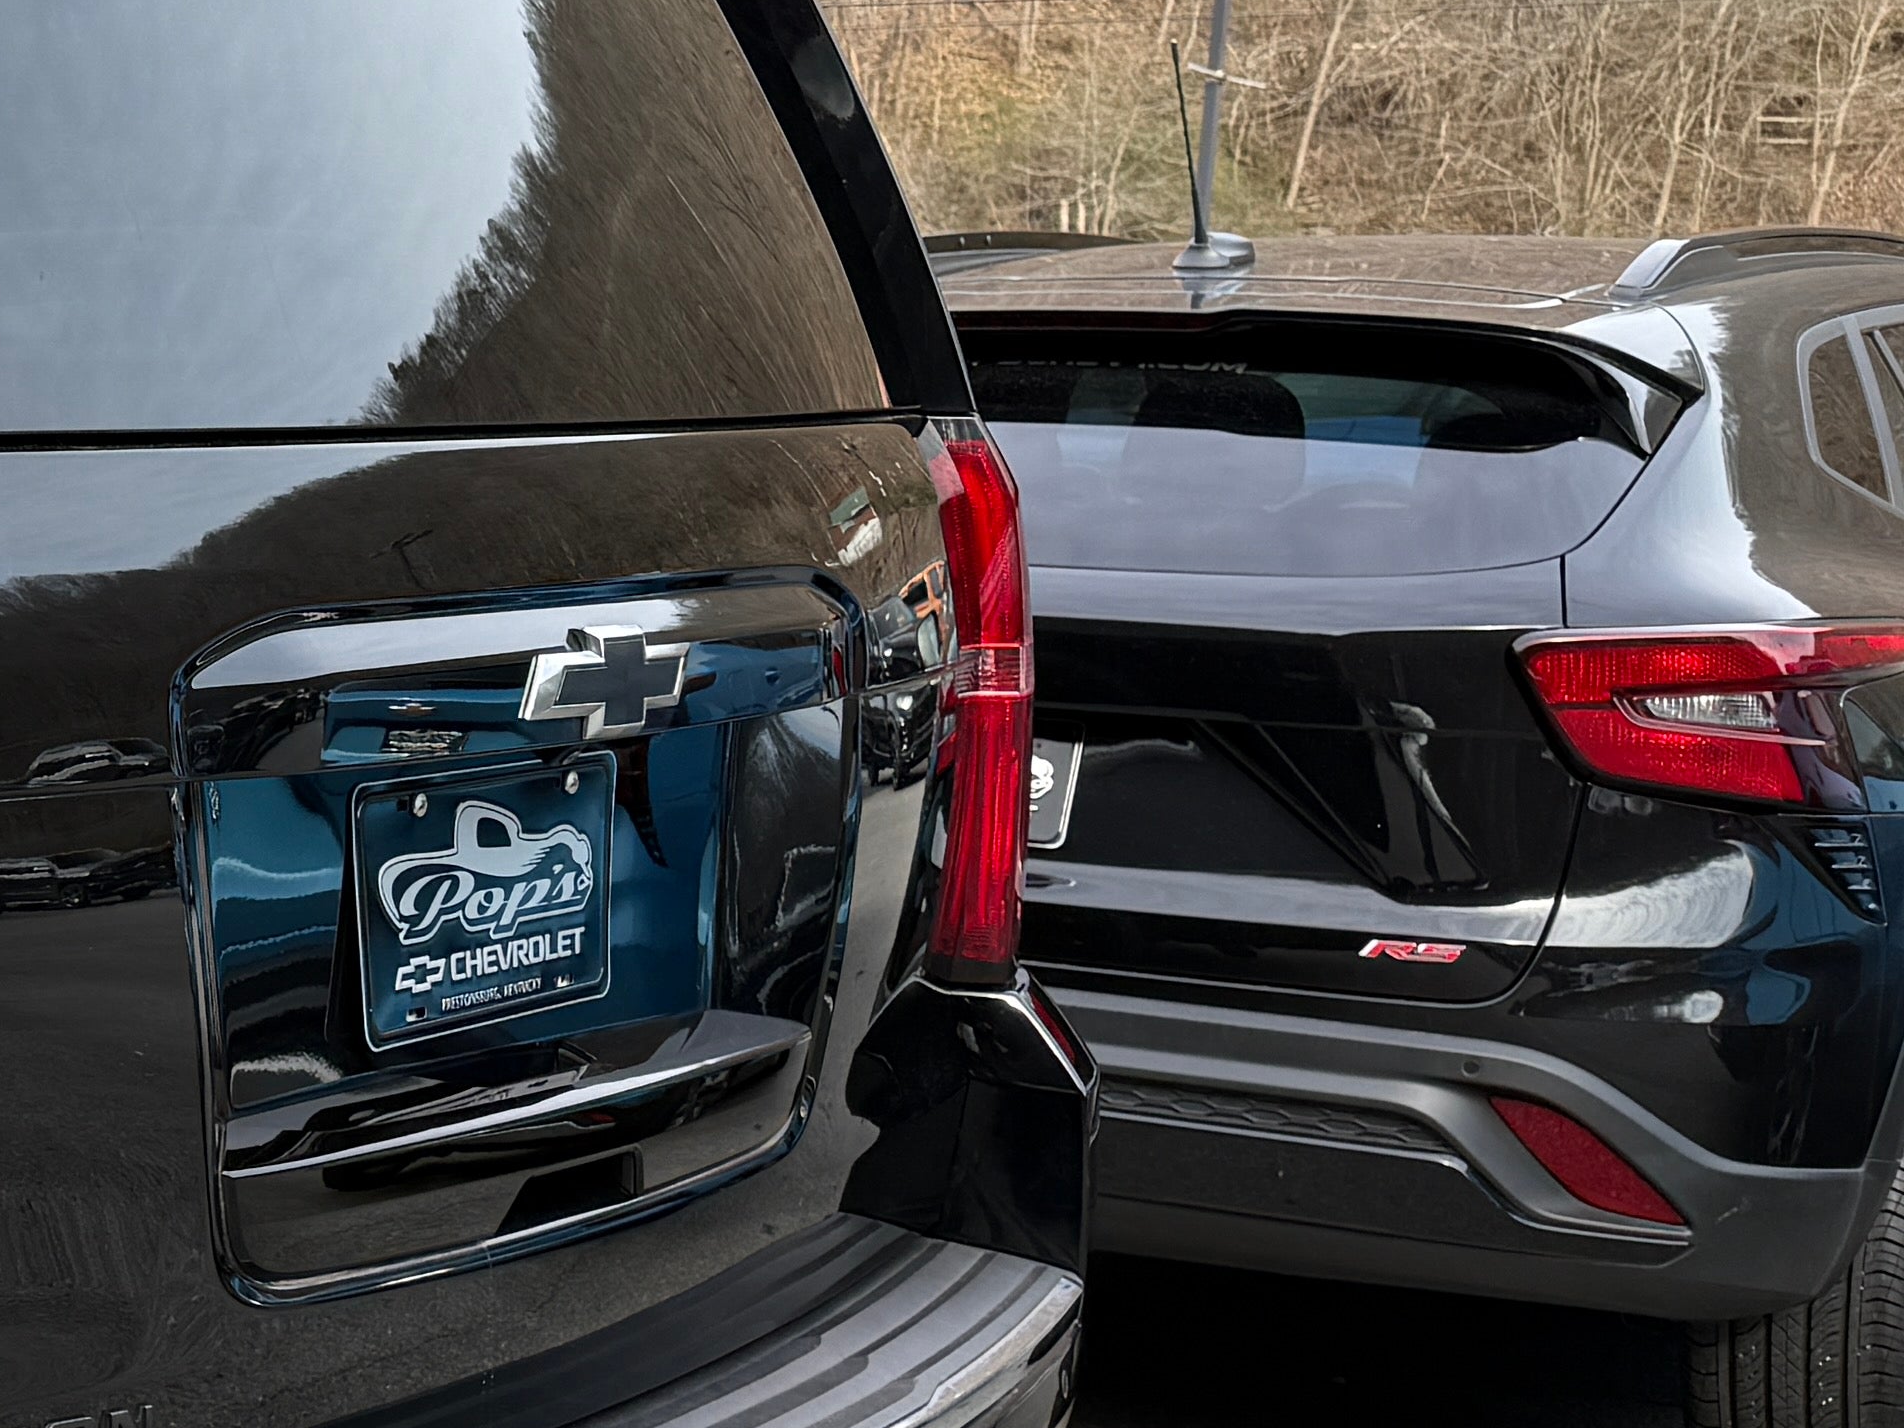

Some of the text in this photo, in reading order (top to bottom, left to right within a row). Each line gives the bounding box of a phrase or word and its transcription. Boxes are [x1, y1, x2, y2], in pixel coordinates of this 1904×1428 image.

[398, 863, 582, 929] Pop's
[450, 926, 585, 982] CHEVROLET
[1358, 938, 1467, 964] RS
